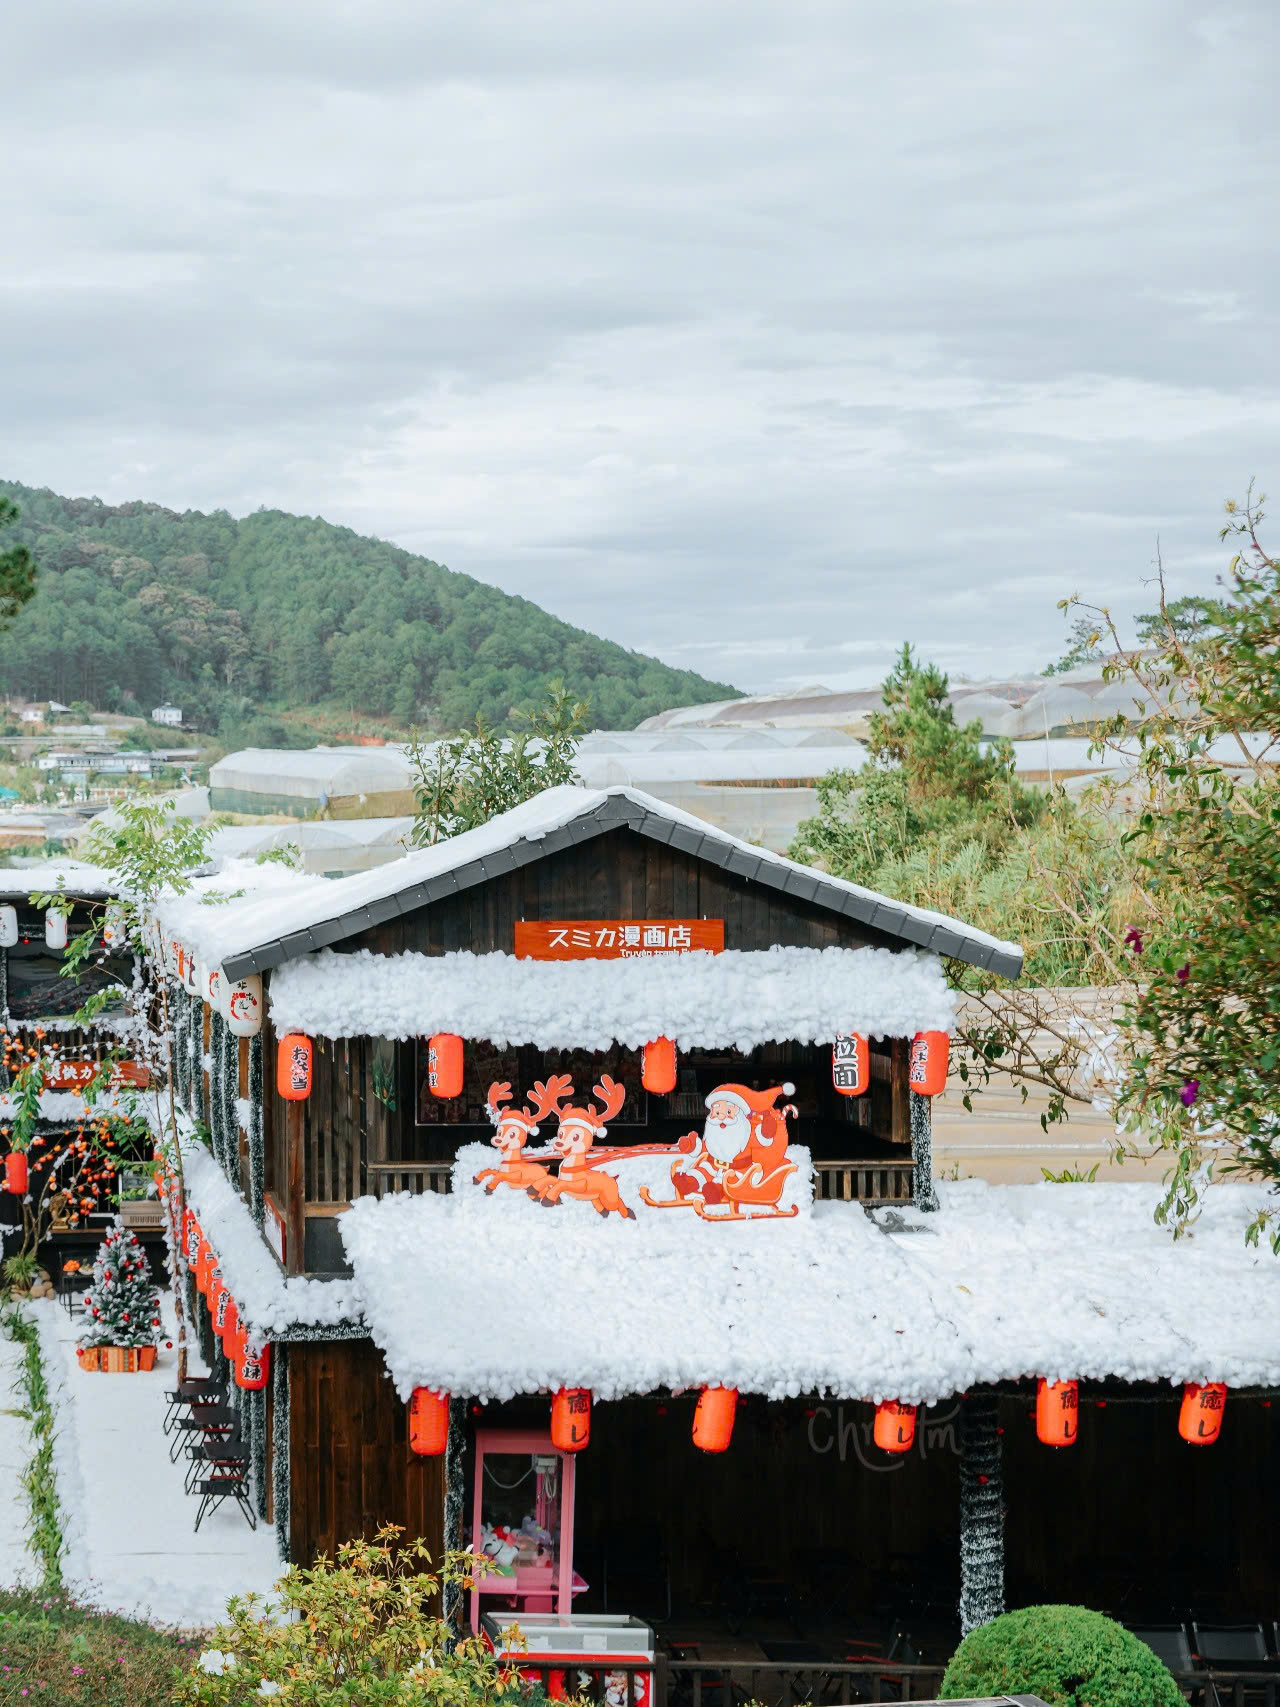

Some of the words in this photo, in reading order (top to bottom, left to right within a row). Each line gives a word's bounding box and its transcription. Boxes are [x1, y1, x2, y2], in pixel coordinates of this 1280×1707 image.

[548, 924, 692, 948] スミカ漫画店
[290, 1045, 308, 1090] お弁当
[567, 1391, 590, 1443] 癒し
